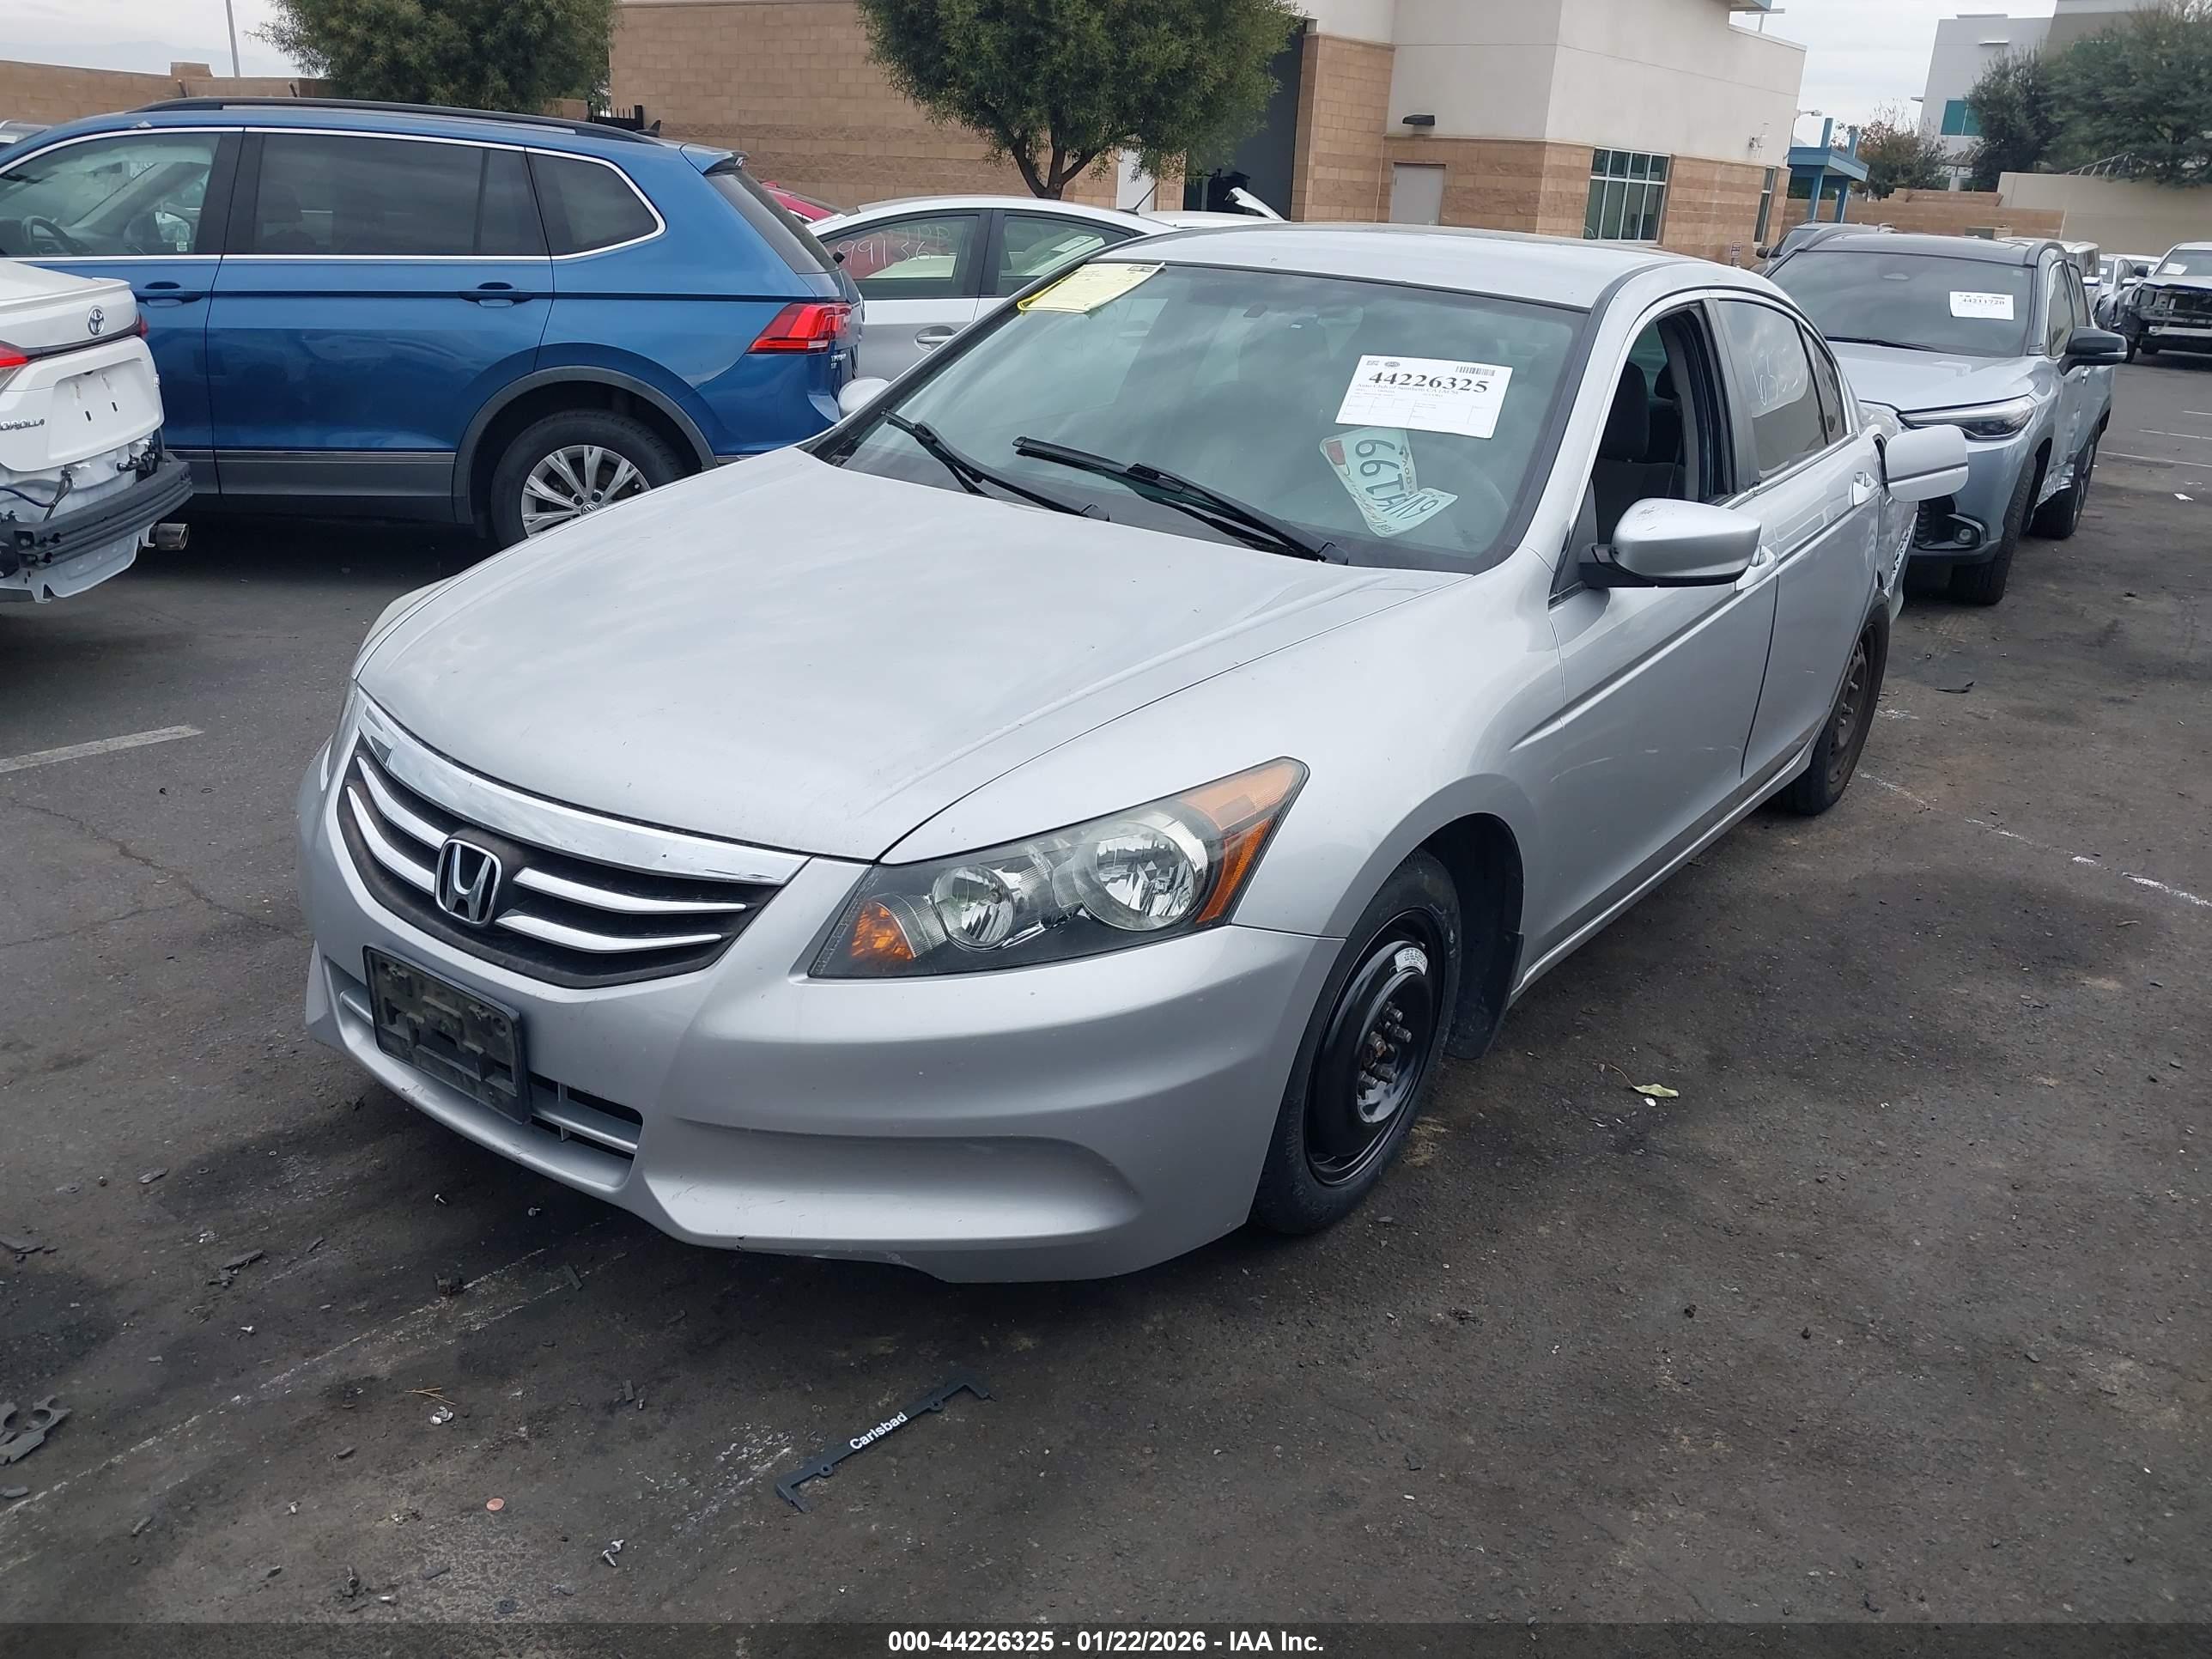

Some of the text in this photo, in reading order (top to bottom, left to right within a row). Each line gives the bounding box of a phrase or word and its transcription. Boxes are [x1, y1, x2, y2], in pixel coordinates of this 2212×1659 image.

[1368, 372, 1491, 393] 44226325
[0, 418, 45, 431] OROLLA
[849, 1412, 908, 1450] Carlsbad
